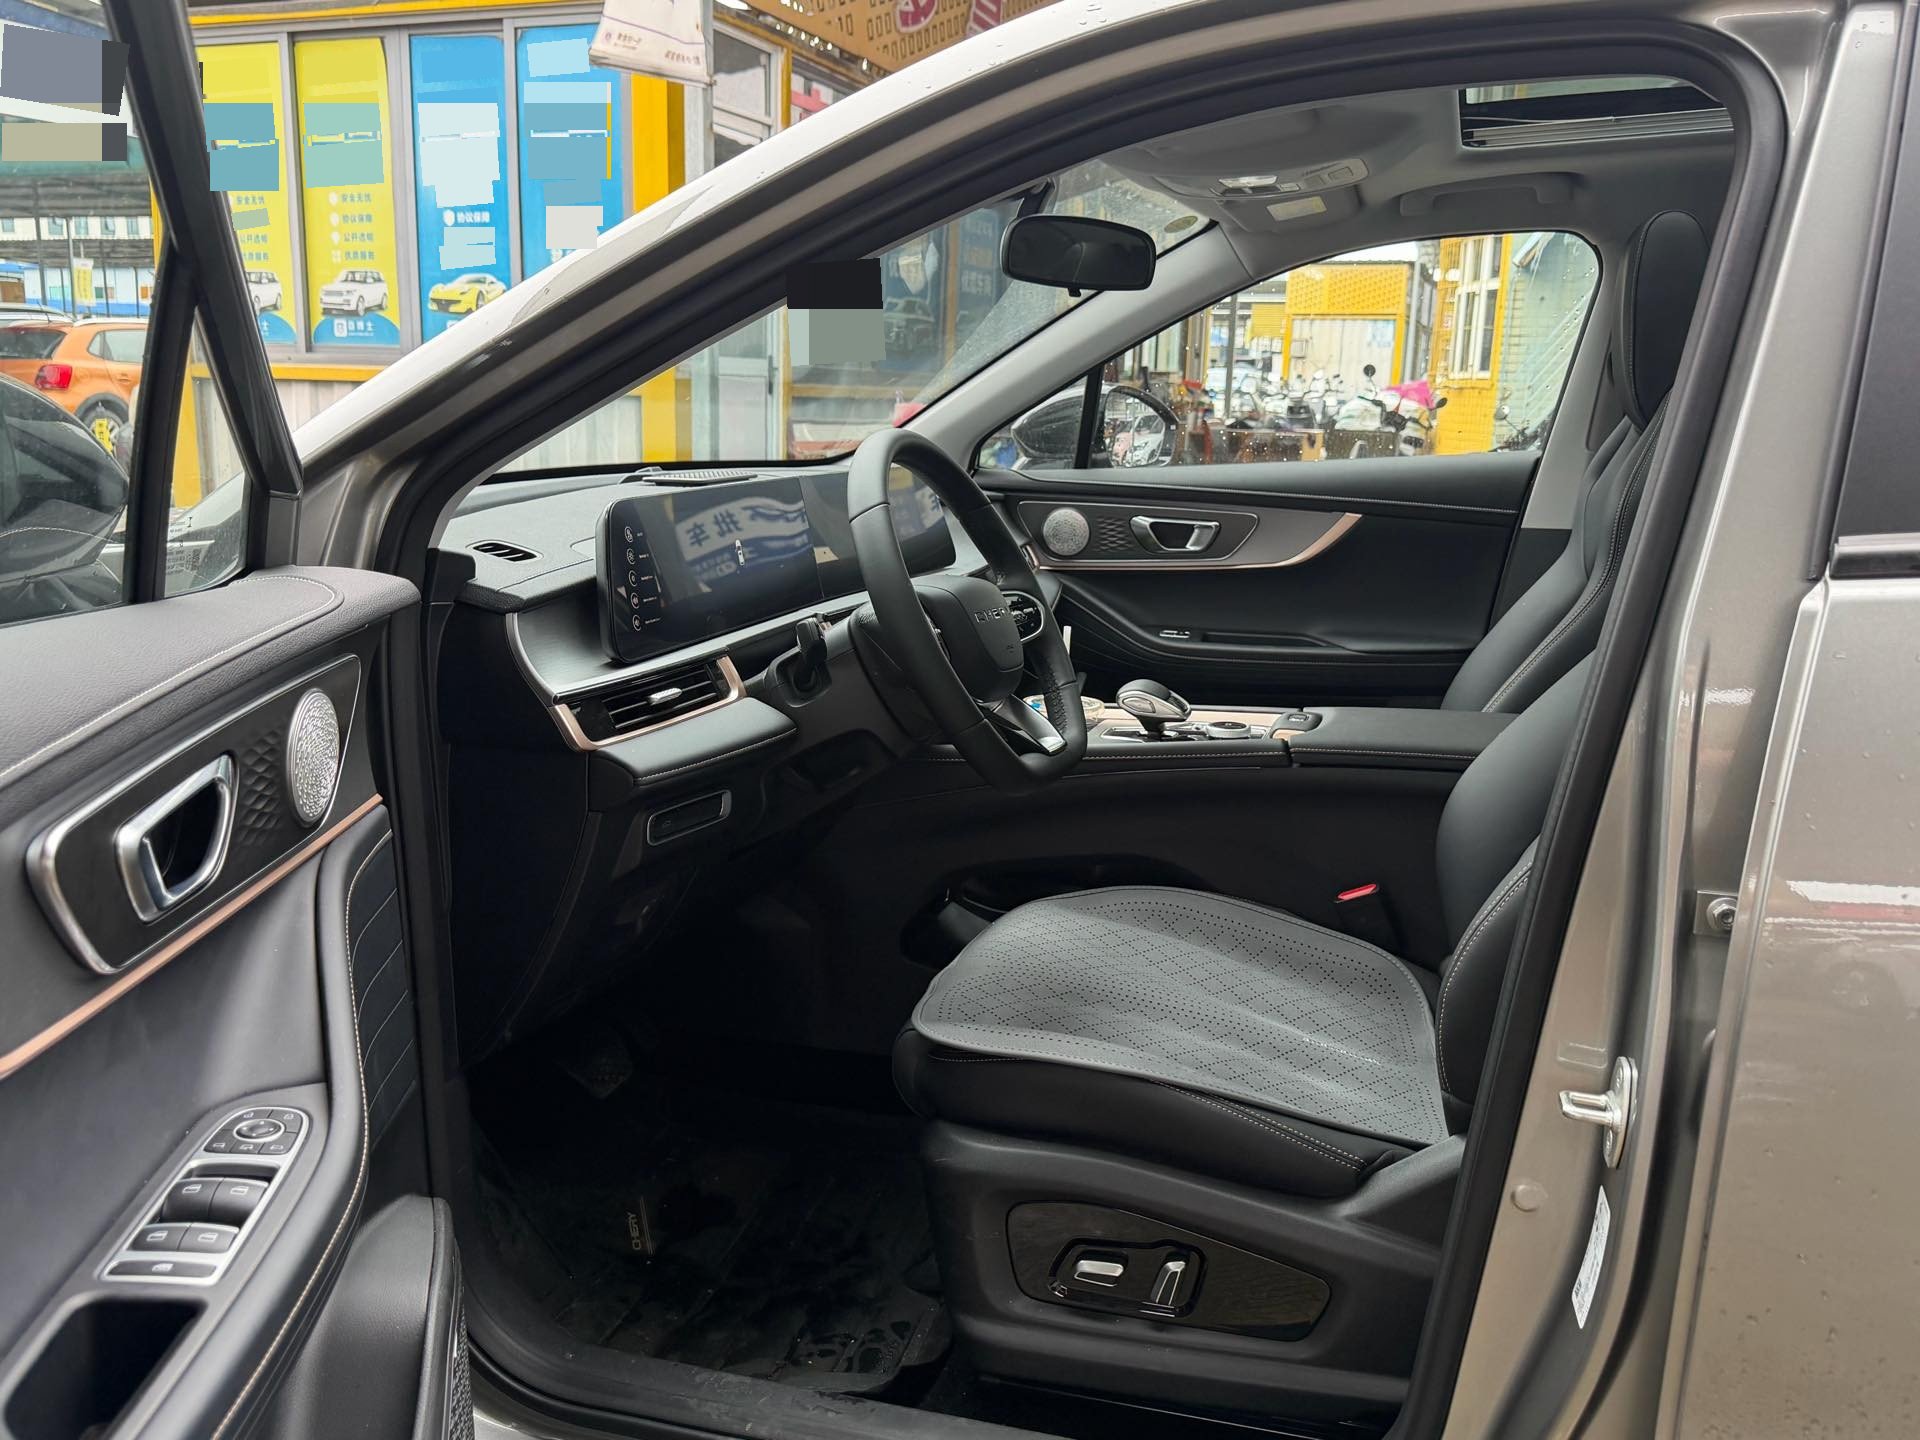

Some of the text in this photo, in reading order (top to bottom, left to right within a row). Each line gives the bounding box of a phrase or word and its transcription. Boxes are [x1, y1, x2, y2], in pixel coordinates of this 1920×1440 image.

[341, 193, 371, 203] 安全无忧
[456, 211, 490, 223] 协议保障
